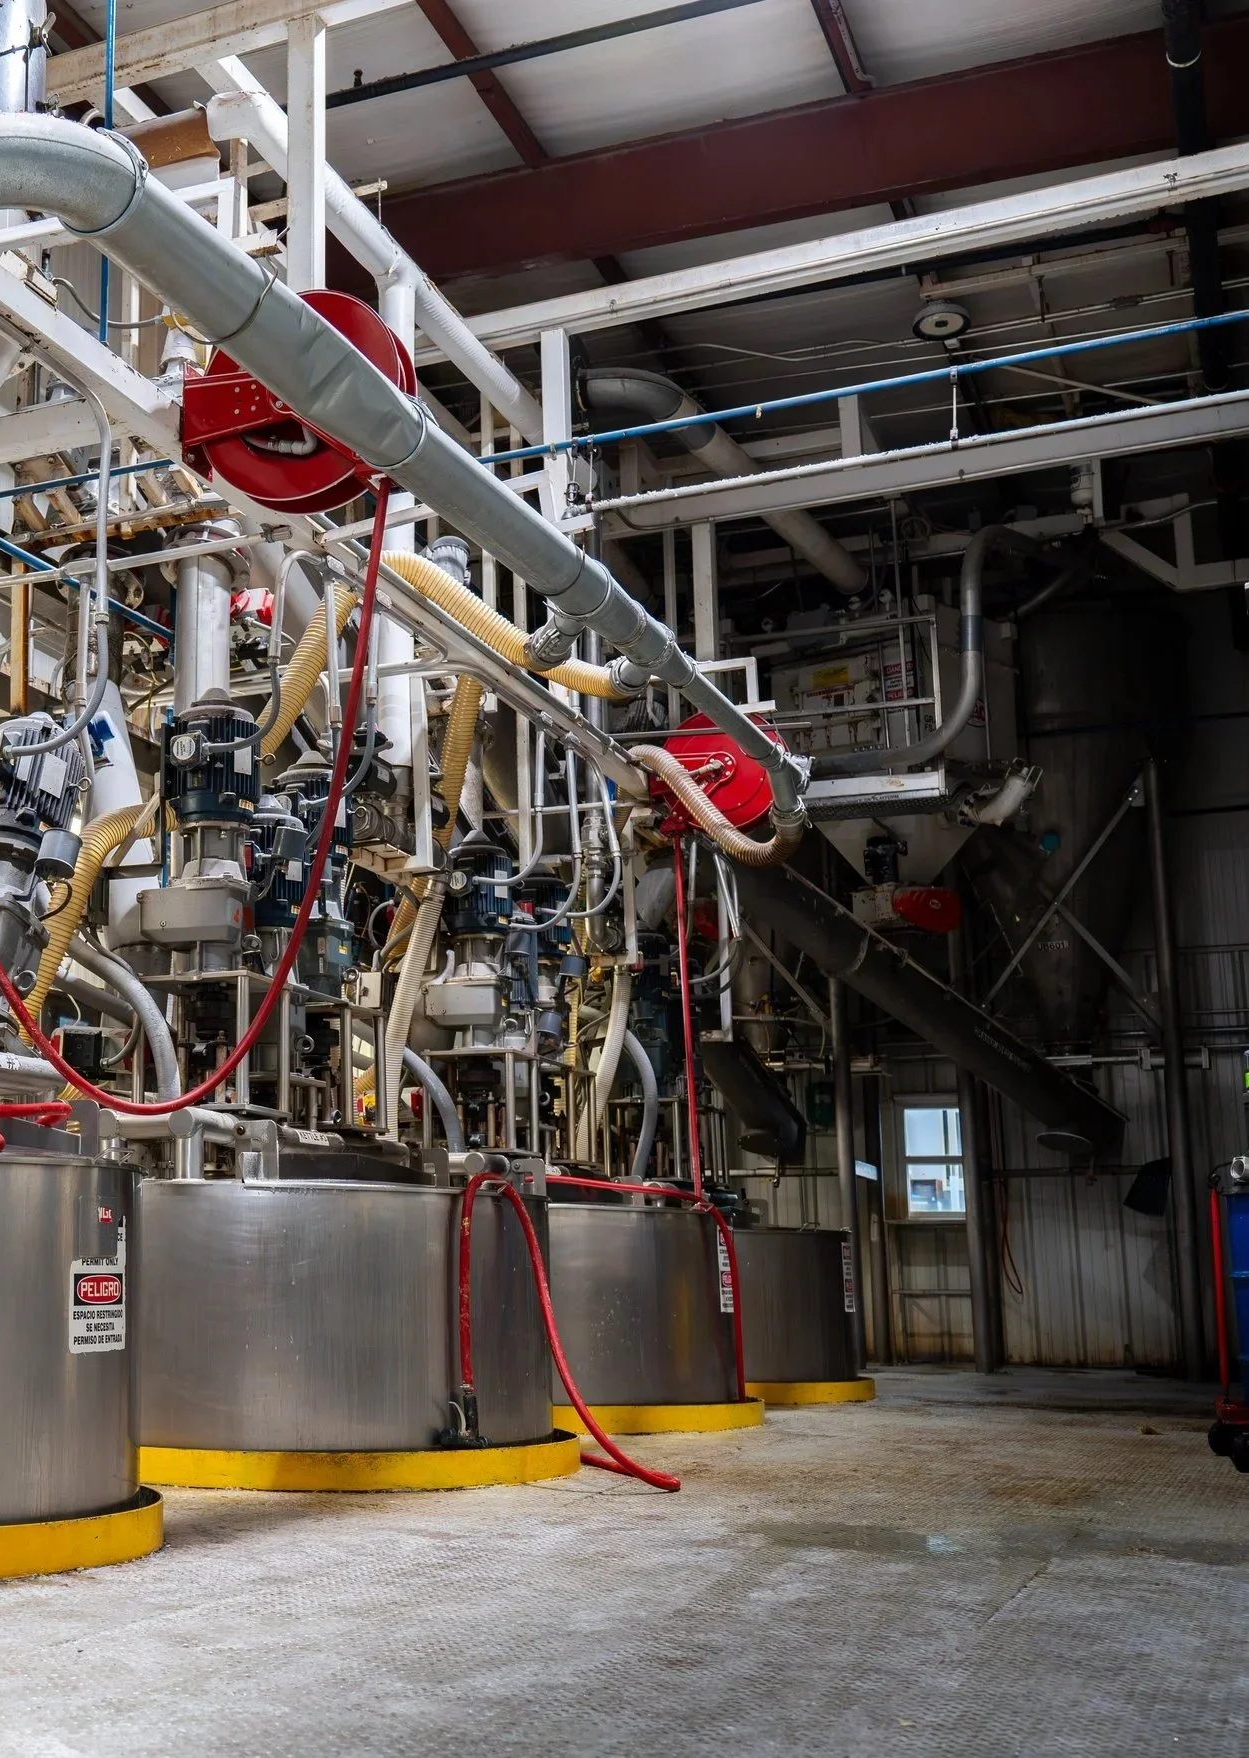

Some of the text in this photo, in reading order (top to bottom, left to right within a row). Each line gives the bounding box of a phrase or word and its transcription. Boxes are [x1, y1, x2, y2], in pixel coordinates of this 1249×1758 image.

[80, 1281, 119, 1297] PELIGRO
[73, 1309, 123, 1321] ESPACIO RESTRINGIDO
[86, 1322, 115, 1332] SE NECESITA
[74, 1334, 123, 1345] PERMISO DE ENTRADA
